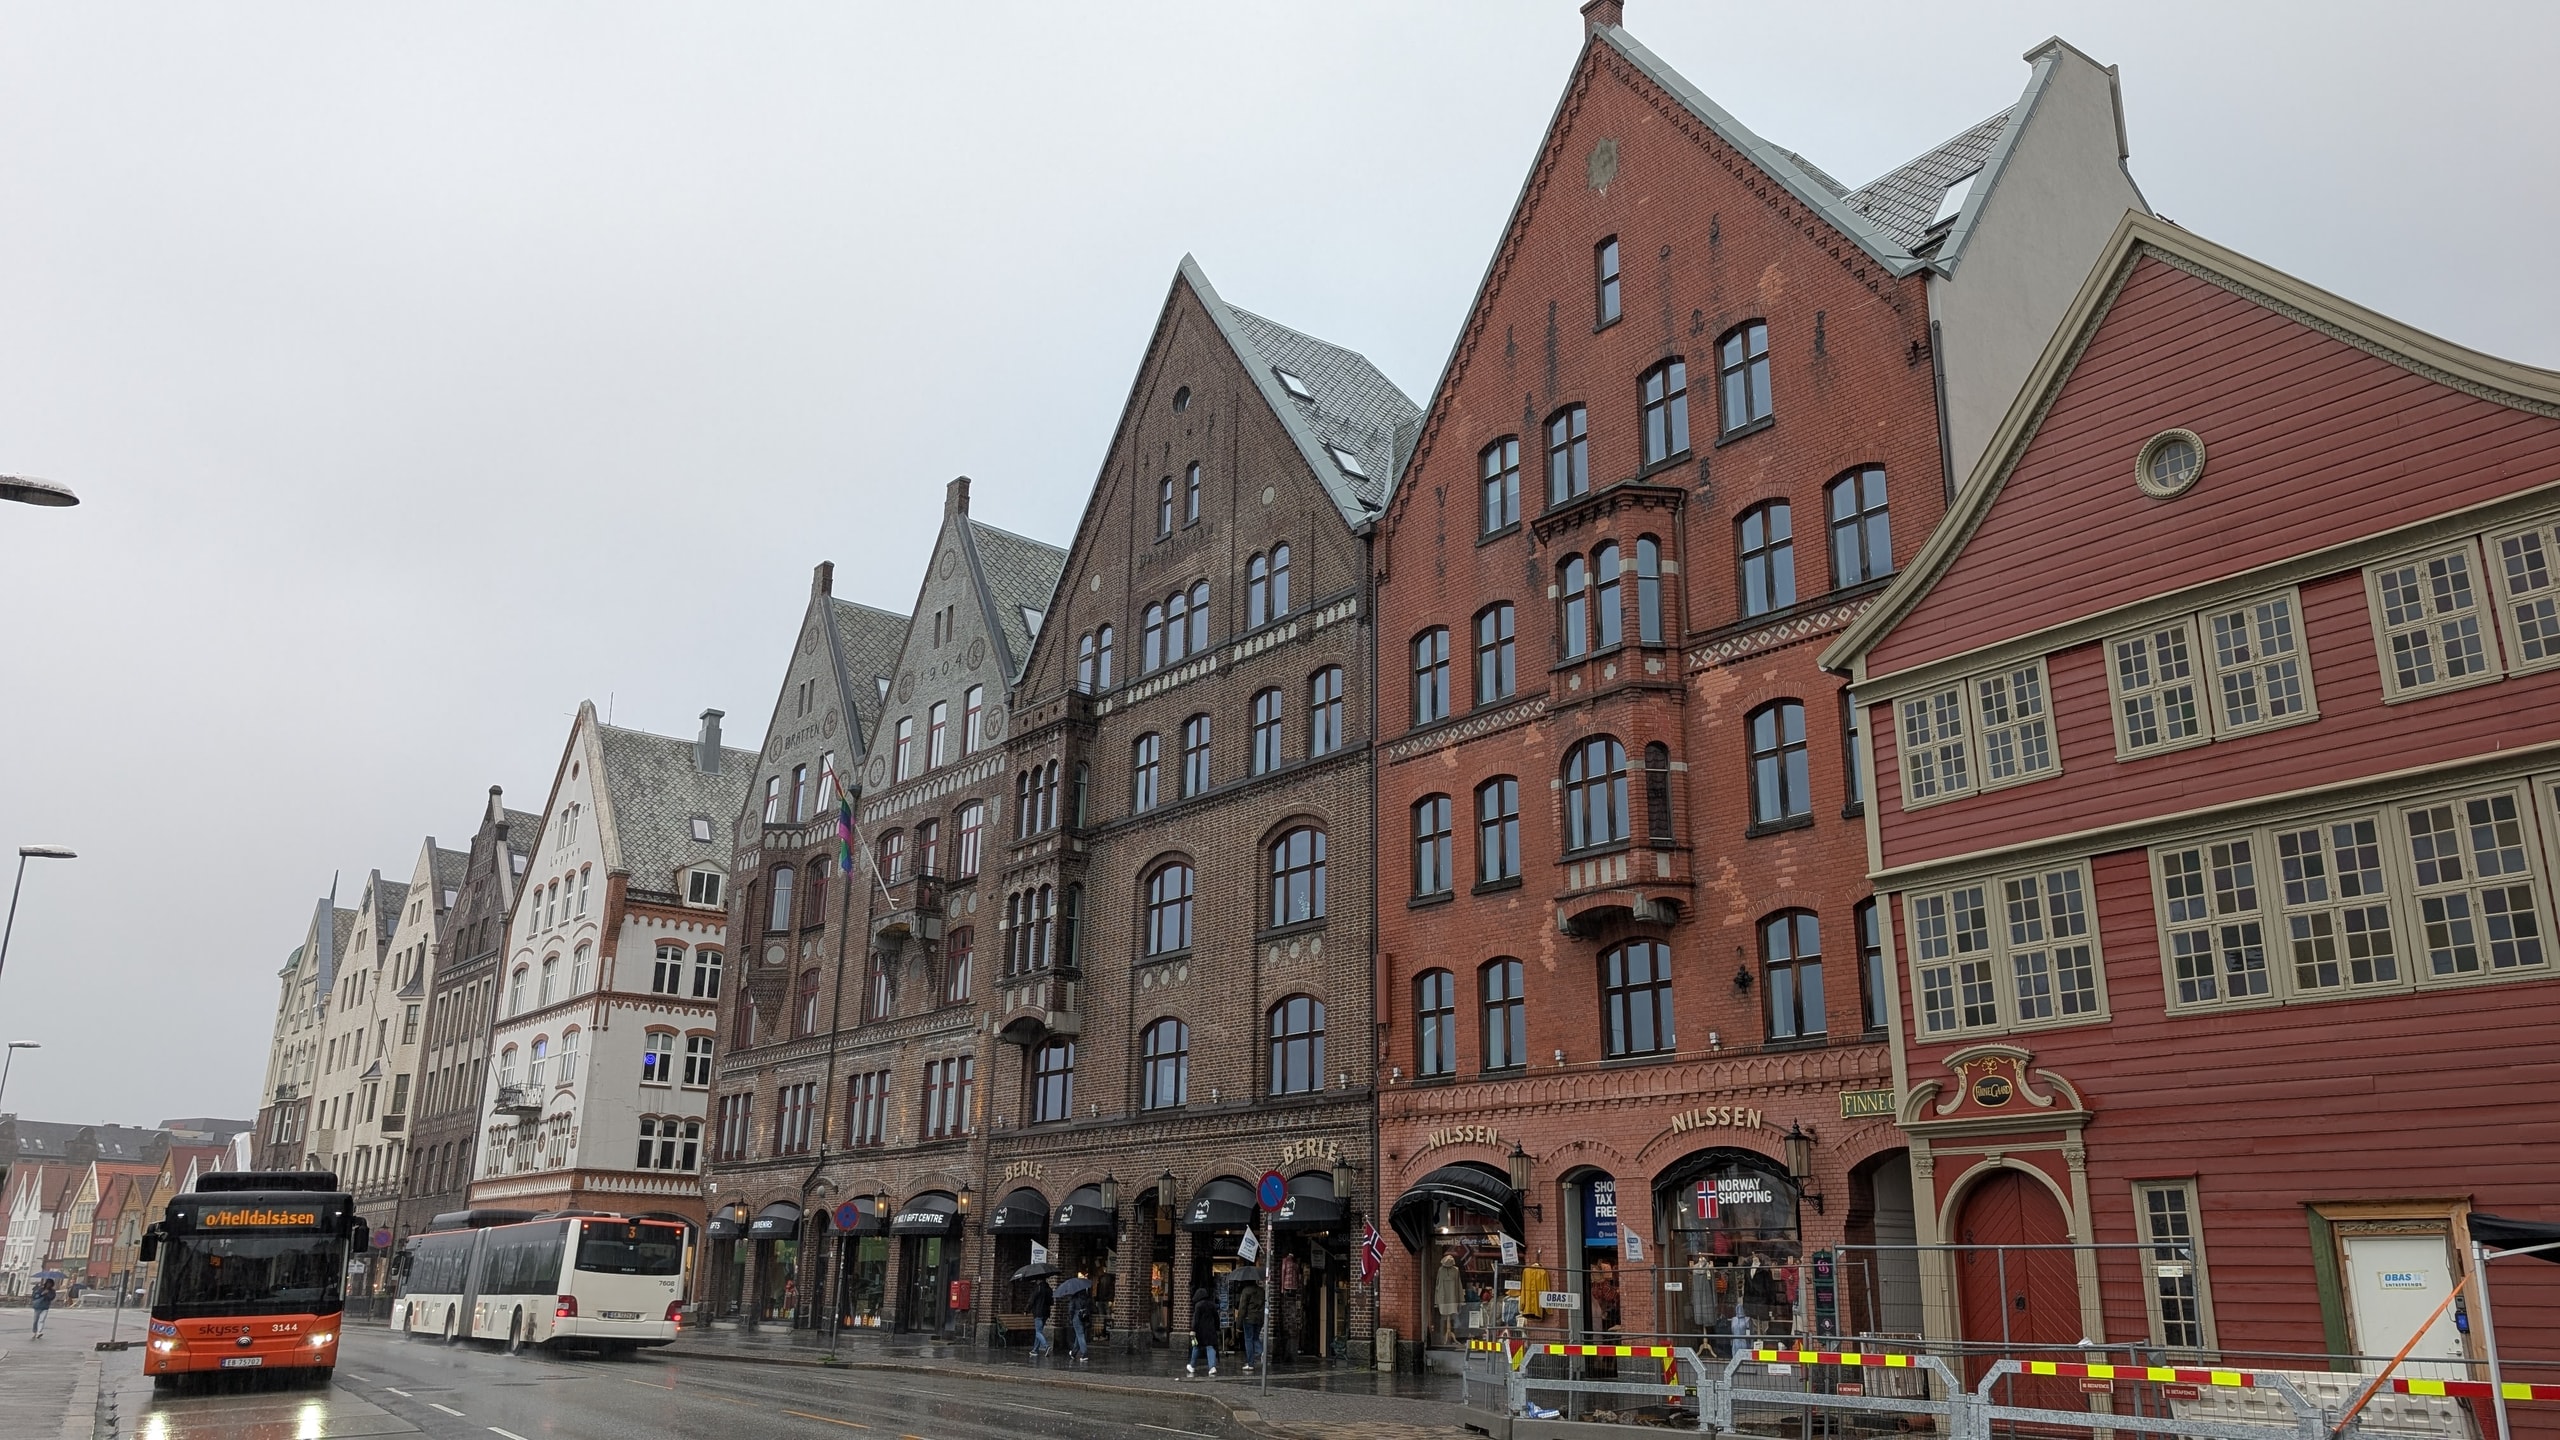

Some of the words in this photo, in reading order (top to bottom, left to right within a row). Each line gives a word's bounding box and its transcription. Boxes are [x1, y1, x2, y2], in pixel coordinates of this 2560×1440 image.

[920, 652, 963, 686] 1904
[785, 721, 820, 750] BRATTEN
[1671, 1106, 1762, 1134] NILSSEN
[1428, 1125, 1499, 1150] NILSSEN
[1283, 1138, 1339, 1166] BERLE
[1005, 1160, 1043, 1181] BERLE
[1717, 1178, 1760, 1191] NORWAY
[1594, 1193, 1613, 1205] TAX
[1718, 1190, 1772, 1204] SHOPPING
[206, 1209, 315, 1226] o/Helldalsåsen
[907, 1213, 919, 1222] GIFT
[918, 1213, 944, 1224] CENTRE
[1595, 1206, 1617, 1218] FREE
[628, 1226, 636, 1239] 3
[2384, 1273, 2412, 1282] OBAS
[1546, 1293, 1567, 1303] OBAS
[200, 1324, 240, 1337] skyss
[271, 1323, 298, 1332] 3144
